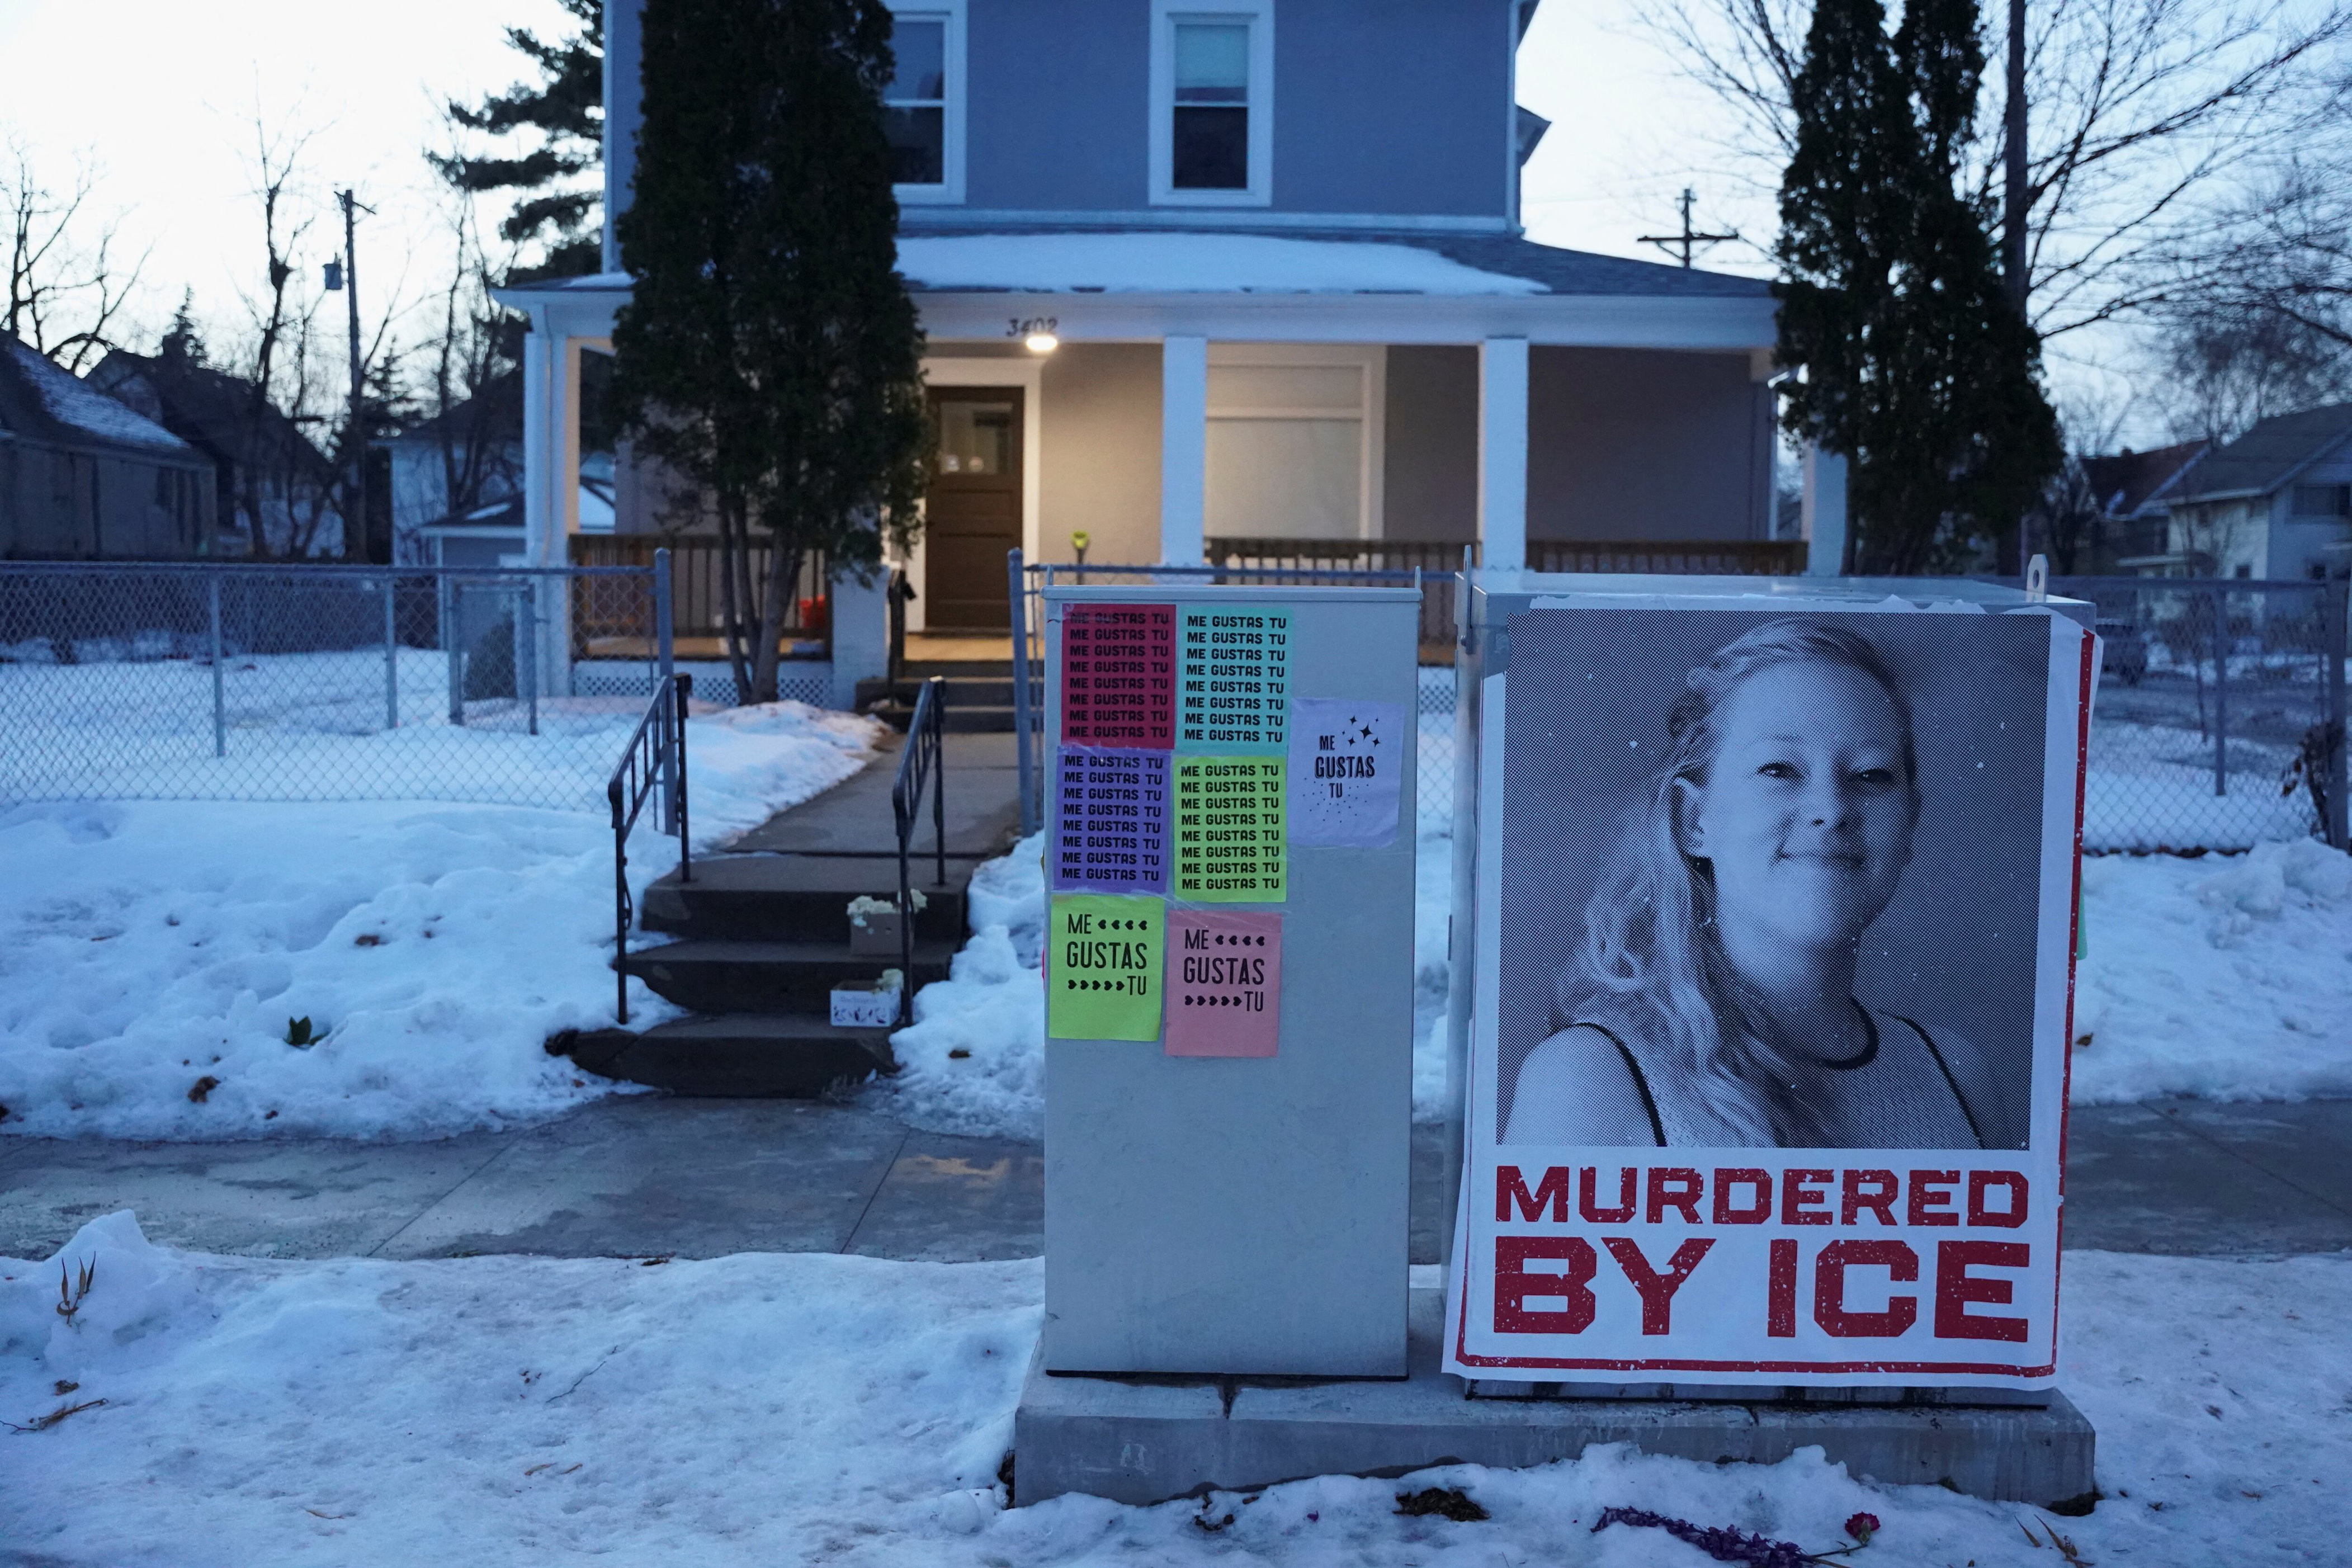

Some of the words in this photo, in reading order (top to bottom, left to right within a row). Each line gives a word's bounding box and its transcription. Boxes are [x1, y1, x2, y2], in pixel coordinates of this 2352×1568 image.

[1070, 612, 1089, 624] ME
[1095, 613, 1145, 624] GUSTAS
[1152, 613, 1169, 624] TU
[1188, 616, 1206, 626] ME
[1212, 616, 1263, 627] GUSTAS
[1269, 617, 1286, 629] TU
[1070, 629, 1089, 640] ME
[1095, 629, 1145, 640] GUSTAS
[1151, 630, 1168, 640] TU
[1188, 632, 1206, 643] ME
[1212, 632, 1262, 644] GUSTAS
[1269, 634, 1285, 645] TU
[1070, 645, 1089, 656] ME
[1094, 645, 1145, 657] GUSTAS
[1151, 646, 1168, 657] TU
[1187, 649, 1206, 659] ME
[1212, 649, 1262, 660] GUSTAS
[1268, 650, 1284, 661] TU
[1070, 662, 1089, 672] ME
[1094, 662, 1145, 673] GUSTAS
[1151, 662, 1168, 673] TU
[1187, 665, 1205, 675] ME
[1211, 665, 1261, 677] GUSTAS
[1268, 667, 1284, 677] TU
[1070, 678, 1088, 688] ME
[1094, 678, 1145, 689] GUSTAS
[1151, 678, 1168, 689] TU
[1187, 681, 1205, 691] ME
[1211, 681, 1261, 693] GUSTAS
[1267, 683, 1283, 693] TU
[1070, 694, 1088, 705] ME
[1094, 694, 1145, 705] GUSTAS
[1151, 695, 1168, 705] TU
[1186, 697, 1205, 707] ME
[1211, 697, 1260, 709] GUSTAS
[1267, 699, 1283, 710] TU
[1070, 710, 1088, 721] ME
[1094, 710, 1144, 721] GUSTAS
[1151, 711, 1167, 721] TU
[1186, 714, 1204, 724] ME
[1210, 714, 1260, 725] GUSTAS
[1267, 715, 1283, 726] TU
[1070, 726, 1088, 737] ME
[1094, 726, 1144, 737] GUSTAS
[1151, 727, 1167, 738] TU
[1185, 729, 1203, 740] ME
[1210, 730, 1259, 742] GUSTAS
[1266, 732, 1282, 743] TU
[1320, 735, 1335, 750] ME
[1065, 755, 1083, 766] ME
[1089, 756, 1140, 768] GUSTAS
[1146, 758, 1163, 769] TU
[1315, 756, 1375, 778] GUSTAS
[1182, 766, 1199, 776] ME
[1206, 765, 1255, 776] GUSTAS
[1262, 765, 1278, 776] TU
[1065, 772, 1083, 782] ME
[1089, 772, 1139, 784] GUSTAS
[1146, 774, 1162, 785] TU
[1182, 782, 1199, 792] ME
[1206, 782, 1255, 792] GUSTAS
[1262, 782, 1278, 792] TU
[1329, 783, 1342, 798] TU
[1064, 788, 1083, 799] ME
[1089, 788, 1139, 800] GUSTAS
[1145, 790, 1161, 801] TU
[1182, 799, 1199, 809] ME
[1206, 798, 1256, 809] GUSTAS
[1262, 797, 1278, 808] TU
[1064, 804, 1082, 814] ME
[1088, 805, 1138, 816] GUSTAS
[1144, 806, 1161, 817] TU
[1182, 815, 1200, 825] ME
[1206, 814, 1256, 825] GUSTAS
[1262, 814, 1278, 824] TU
[1064, 820, 1081, 830] ME
[1088, 820, 1137, 832] GUSTAS
[1144, 823, 1160, 833] TU
[1182, 831, 1200, 841] ME
[1206, 830, 1256, 841] GUSTAS
[1263, 830, 1279, 840] TU
[1063, 836, 1081, 847] ME
[1088, 837, 1136, 848] GUSTAS
[1144, 839, 1159, 849] TU
[1182, 847, 1201, 857] ME
[1207, 847, 1257, 857] GUSTAS
[1263, 846, 1279, 857] TU
[1062, 852, 1081, 863] ME
[1087, 853, 1136, 865] GUSTAS
[1143, 854, 1159, 866] TU
[1182, 863, 1201, 873] ME
[1207, 863, 1257, 873] GUSTAS
[1263, 862, 1279, 872] TU
[1062, 868, 1080, 879] ME
[1087, 868, 1136, 880] GUSTAS
[1142, 871, 1159, 881] TU
[1183, 879, 1201, 889] ME
[1207, 879, 1256, 889] GUSTAS
[1263, 879, 1279, 889] TU
[1068, 914, 1092, 934] ME
[1186, 929, 1209, 950] ME
[1067, 942, 1147, 969] GUSTAS
[1184, 957, 1264, 985] GUSTAS
[1127, 976, 1146, 995] TU
[1244, 991, 1263, 1012] TU
[1495, 1165, 2029, 1227] MURDERED
[1494, 1236, 1716, 1335] BY
[1768, 1239, 2029, 1342] ICE
